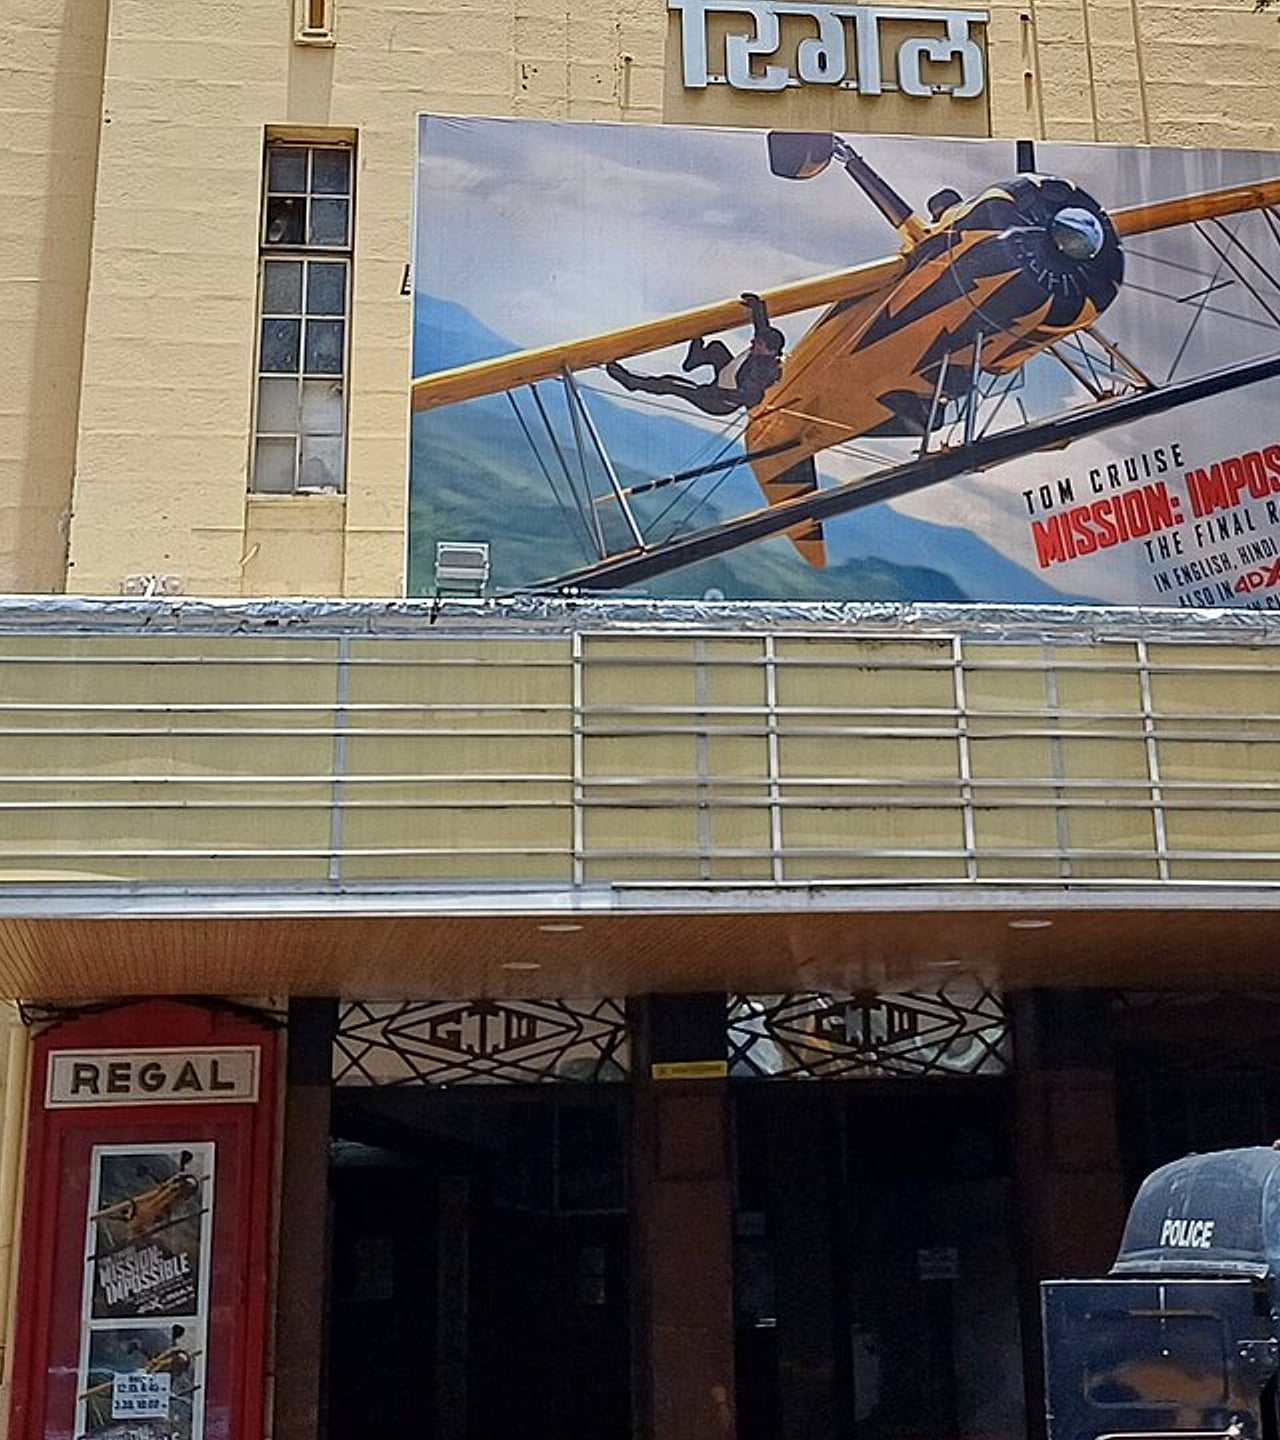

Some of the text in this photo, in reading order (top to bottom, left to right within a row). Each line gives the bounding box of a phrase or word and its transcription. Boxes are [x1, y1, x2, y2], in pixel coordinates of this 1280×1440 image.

[1022, 443, 1185, 515] TOM CRUISE
[1031, 481, 1185, 569] MISSION:
[1144, 531, 1184, 563] THE
[1194, 509, 1255, 548] FINAL
[1153, 573, 1171, 593] IN
[1174, 551, 1237, 588] ENGLISH,
[1220, 580, 1235, 601] IN
[71, 1059, 235, 1094] REGAL
[1160, 1219, 1215, 1248] POLICE
